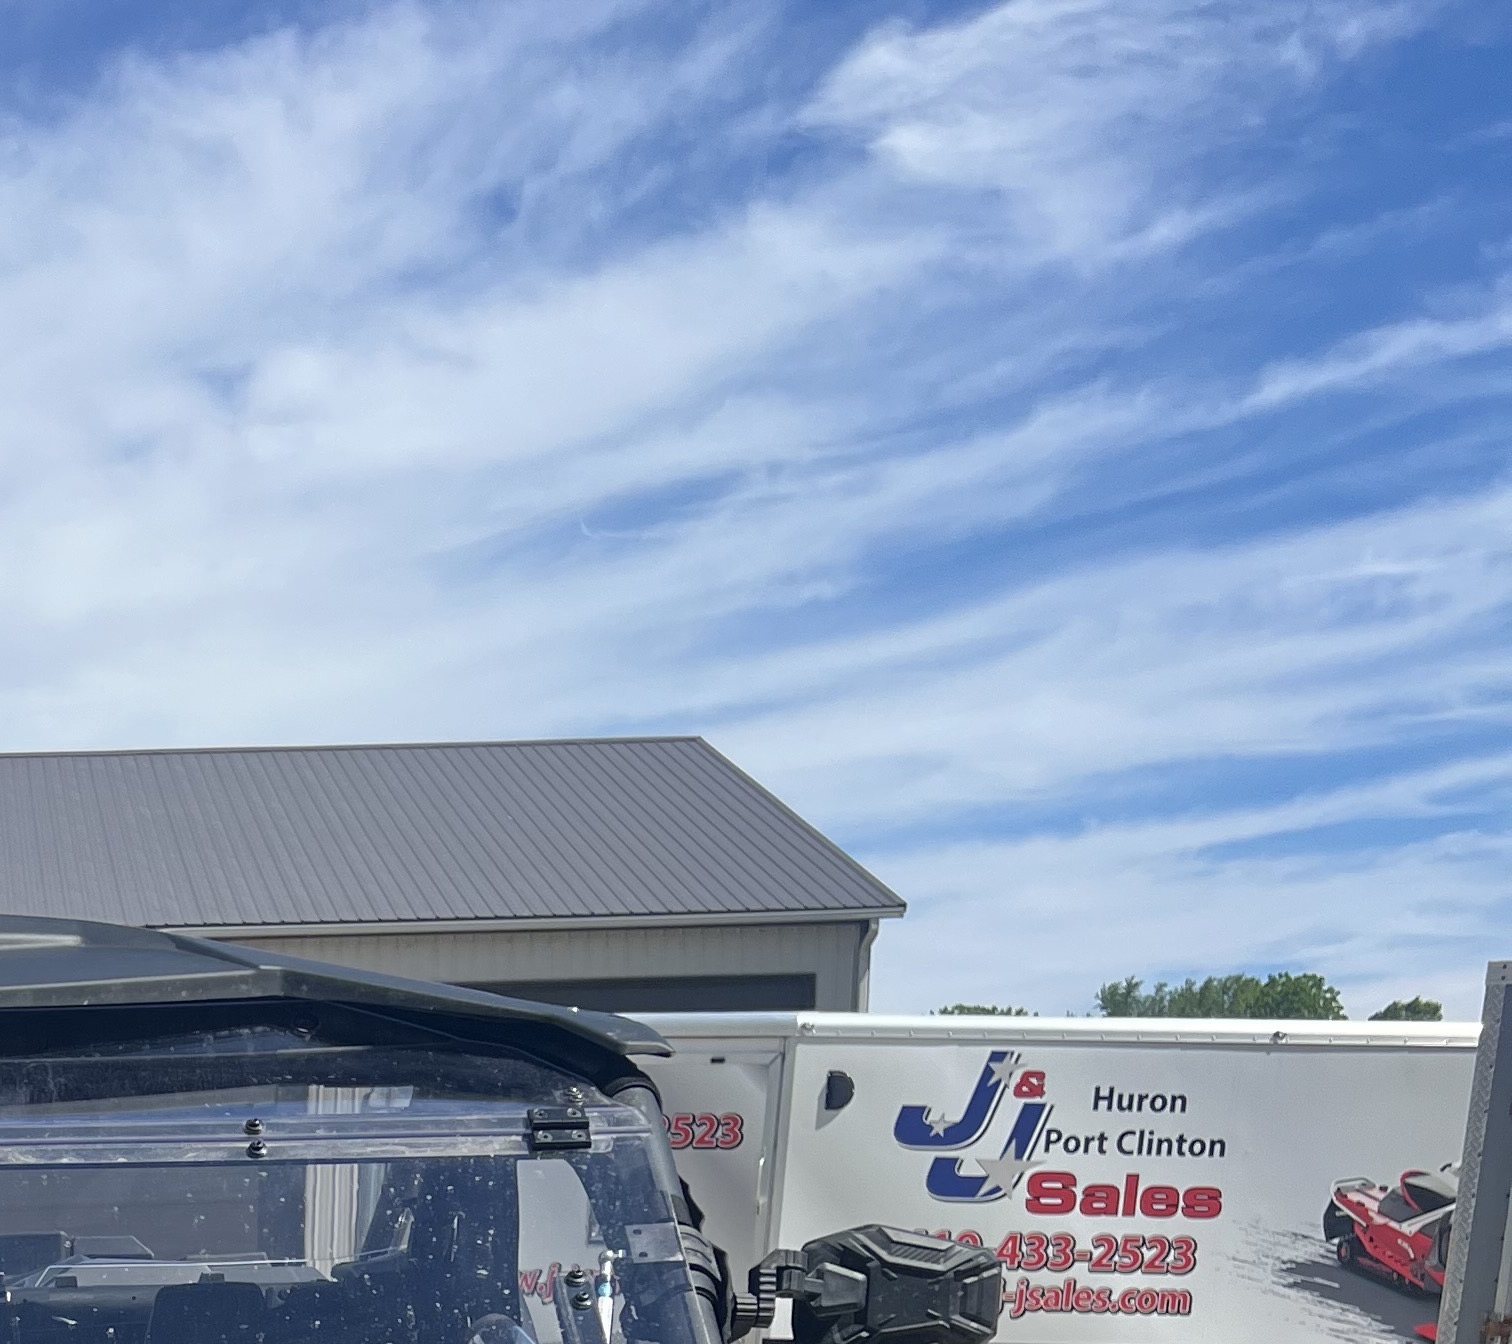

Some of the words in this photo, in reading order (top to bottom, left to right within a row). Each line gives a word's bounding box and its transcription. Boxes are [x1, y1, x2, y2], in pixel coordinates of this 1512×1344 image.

[1091, 1085, 1188, 1114] Huron
[662, 1112, 744, 1149] 523
[1043, 1129, 1108, 1155] Port
[1116, 1130, 1227, 1157] Clinton
[1025, 1171, 1223, 1218] Sales
[998, 1276, 1193, 1318] -jsales.com
